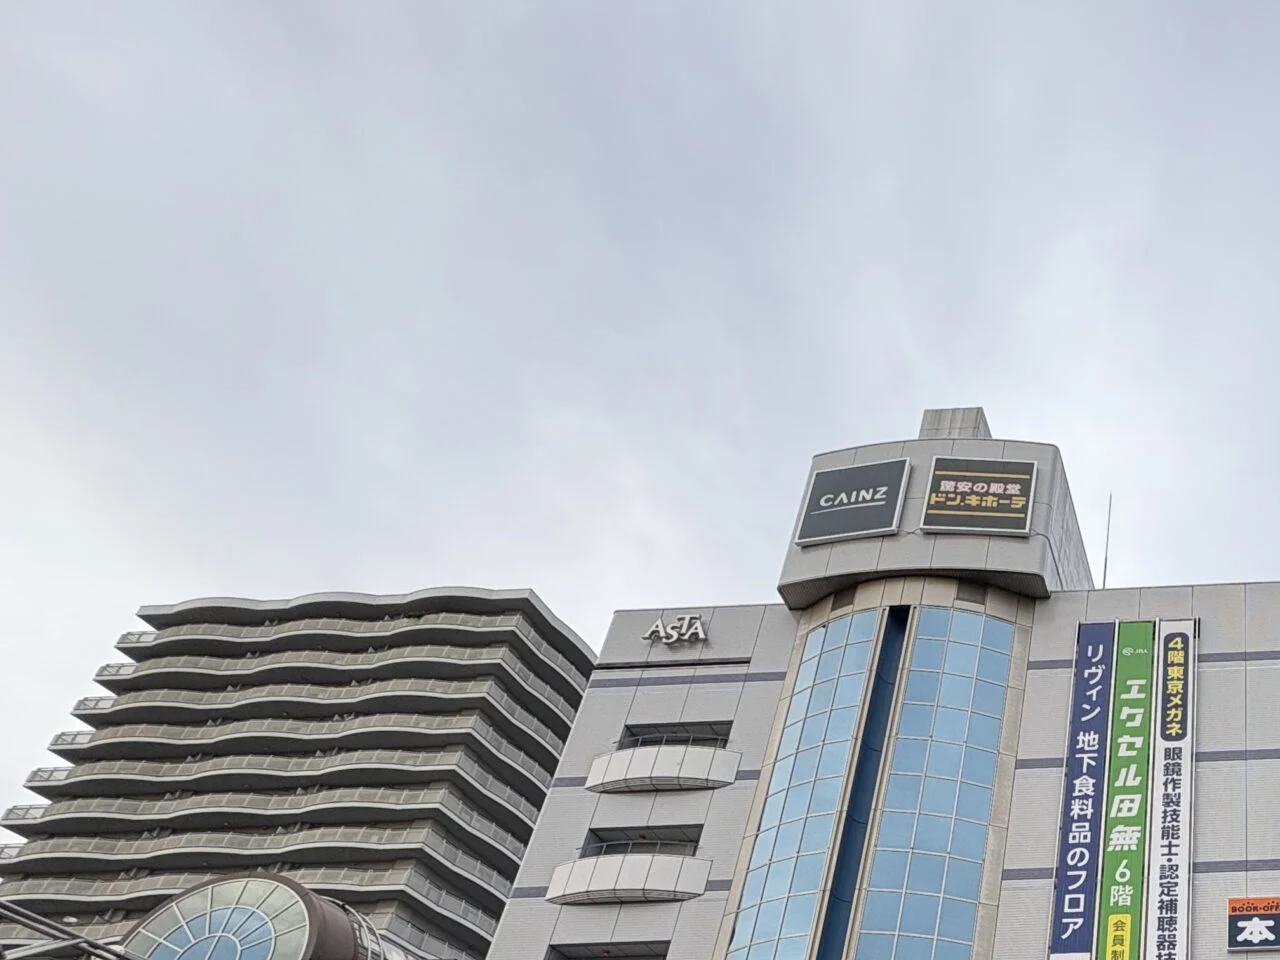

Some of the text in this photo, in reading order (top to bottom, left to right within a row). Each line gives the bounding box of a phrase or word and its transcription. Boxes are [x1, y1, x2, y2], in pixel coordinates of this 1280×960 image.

[819, 486, 889, 507] CAINZ
[939, 480, 1022, 496] 驚安の殿堂
[642, 614, 707, 644] ASTA
